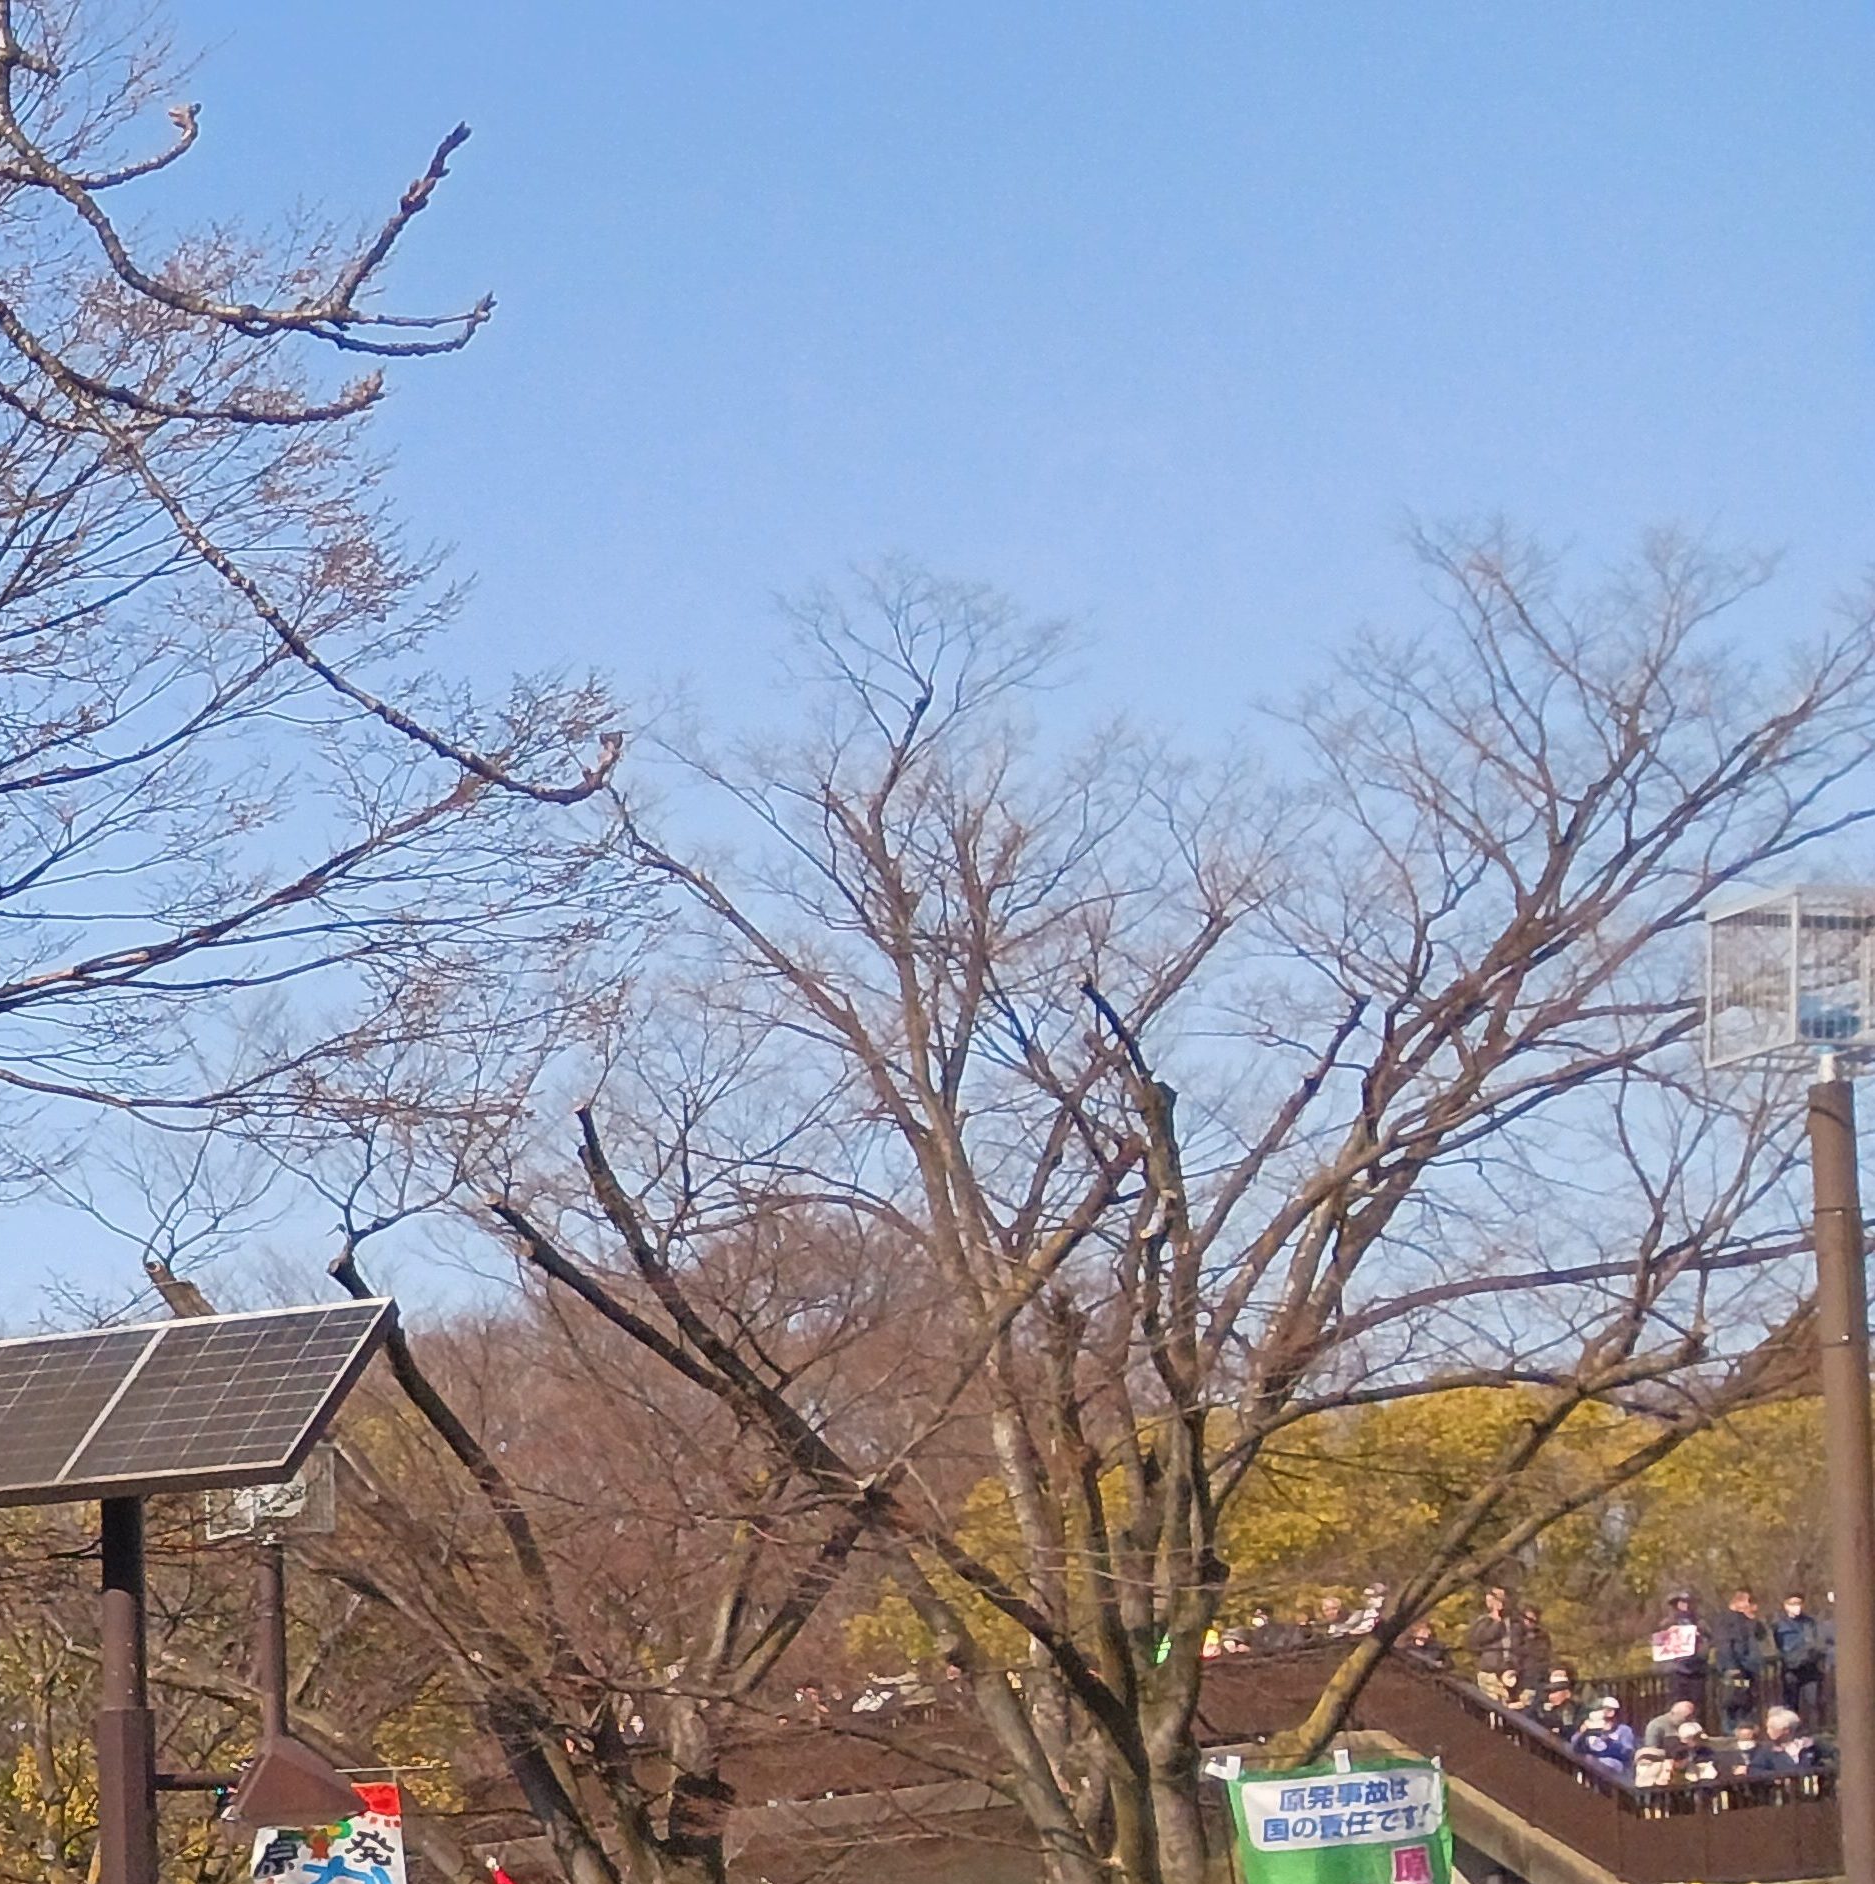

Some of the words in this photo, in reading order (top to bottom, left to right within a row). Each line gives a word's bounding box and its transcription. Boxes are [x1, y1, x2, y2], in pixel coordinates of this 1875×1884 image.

[1279, 1777, 1409, 1813] 原発事故は
[1263, 1802, 1432, 1843] 国の責任です!
[344, 1829, 395, 1867] 発
